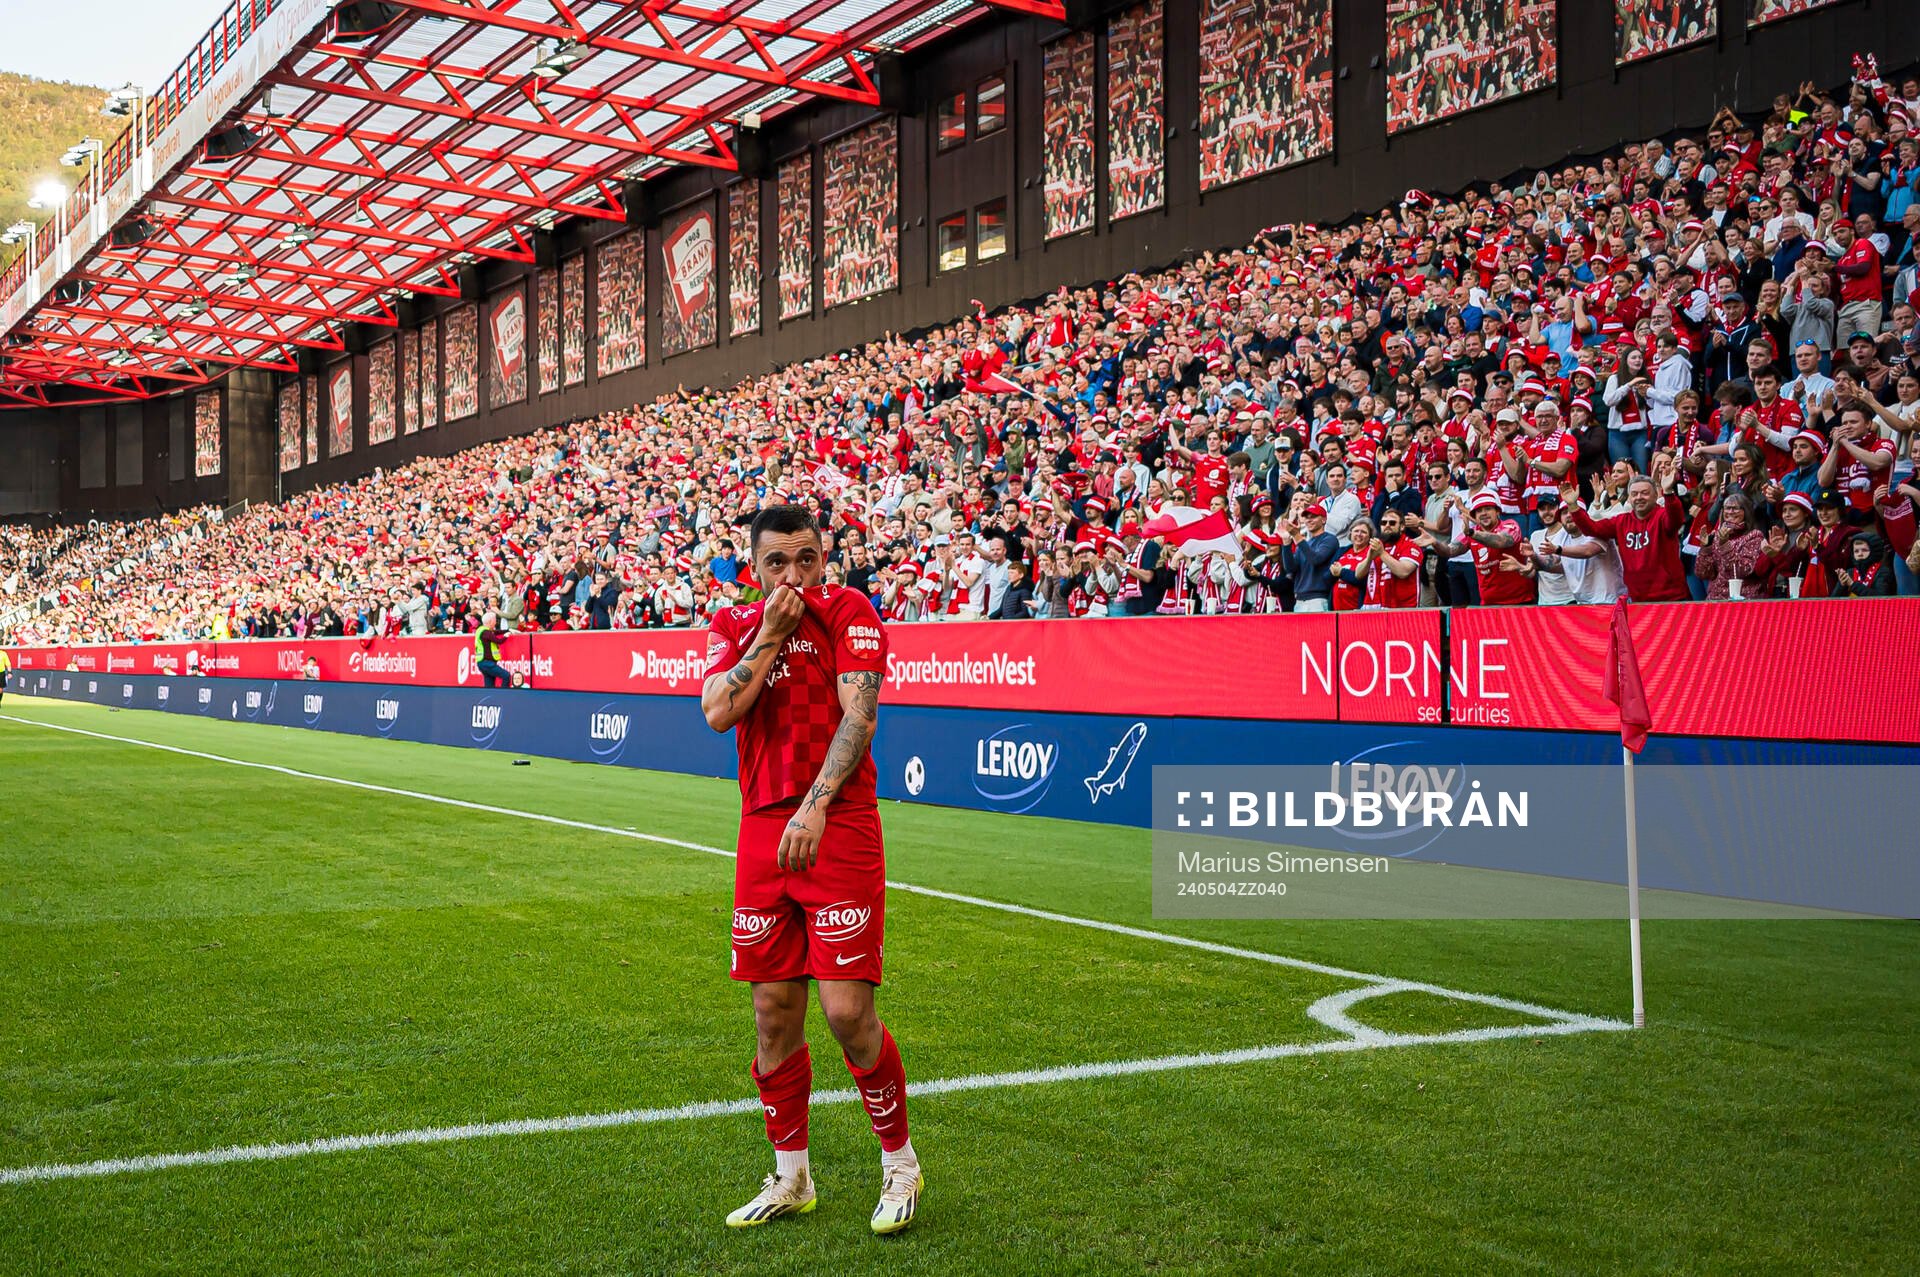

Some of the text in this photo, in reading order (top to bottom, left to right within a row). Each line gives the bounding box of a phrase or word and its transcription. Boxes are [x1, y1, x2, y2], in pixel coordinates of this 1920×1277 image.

[848, 625, 880, 639] REMA
[1301, 639, 1510, 700] NORNE
[471, 705, 501, 729] LERØY
[590, 713, 629, 741] LERØY
[976, 739, 1053, 780] LERØY
